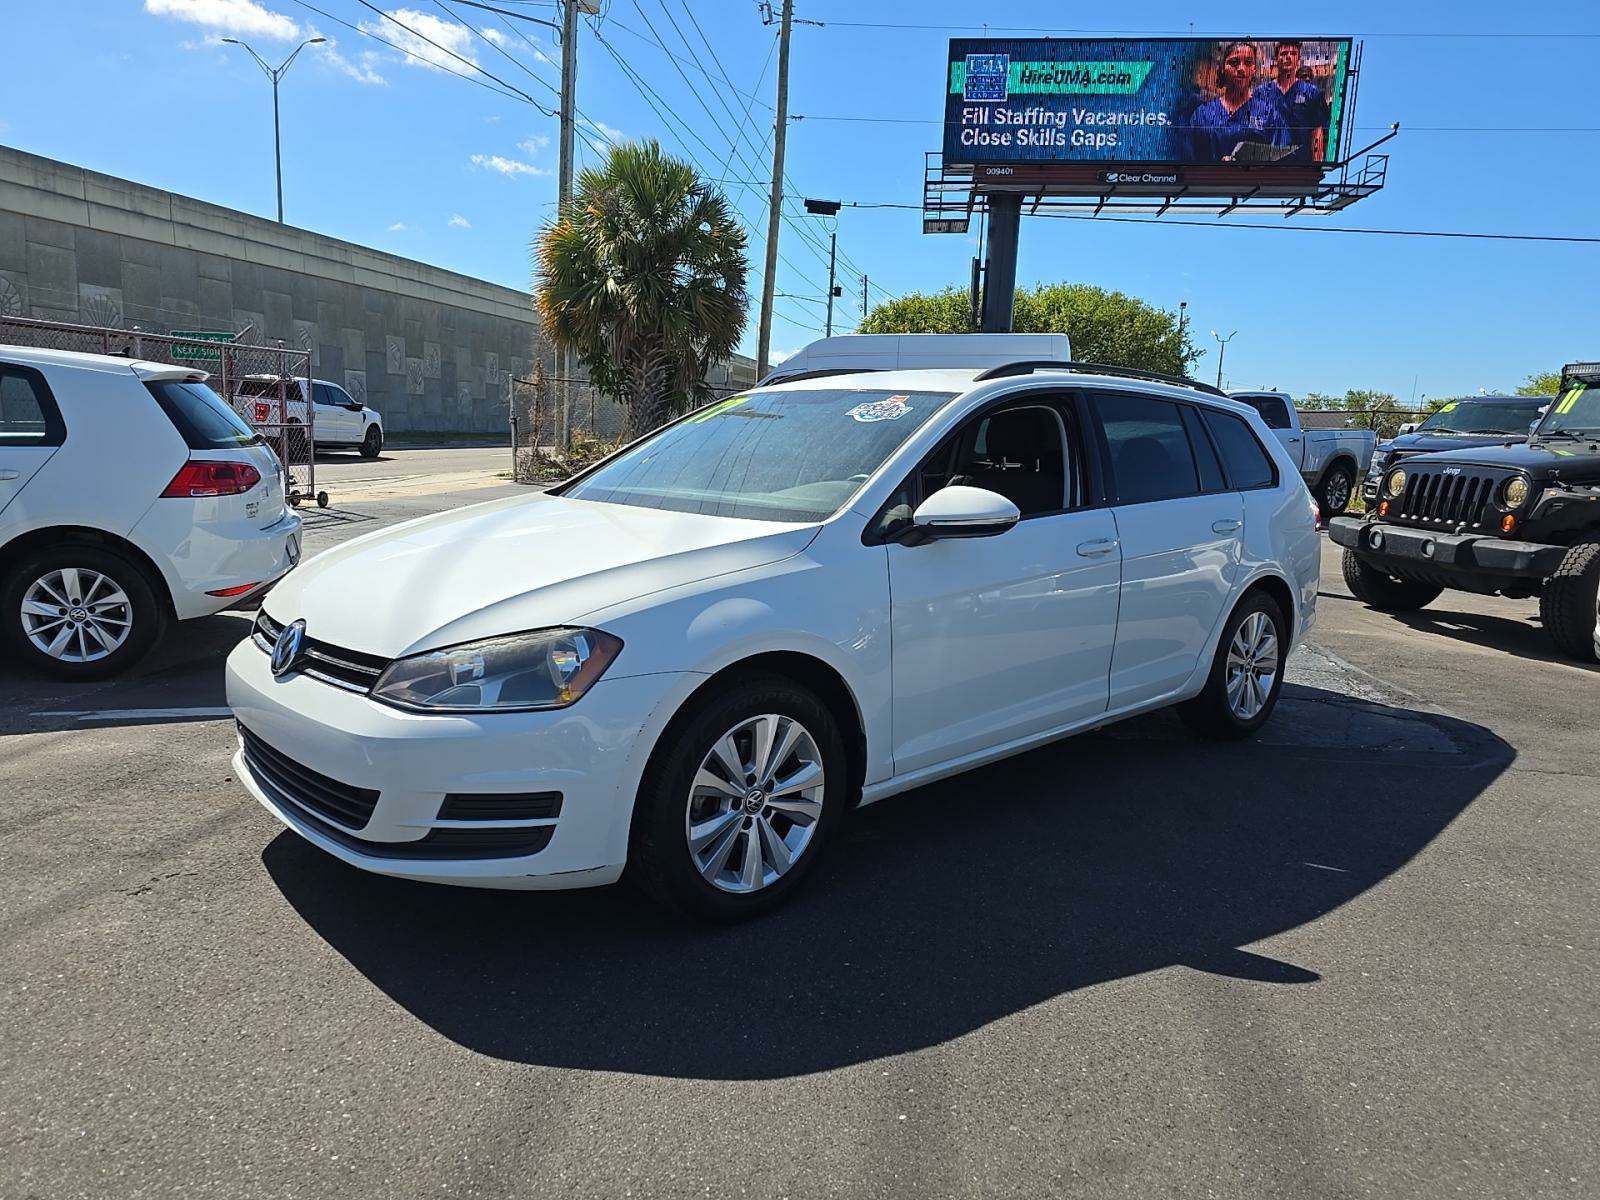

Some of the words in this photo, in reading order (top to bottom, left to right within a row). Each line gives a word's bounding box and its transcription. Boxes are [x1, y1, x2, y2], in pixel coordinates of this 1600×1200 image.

[1020, 69, 1132, 86] HireUMA.com
[962, 107, 989, 125] Fill
[994, 107, 1067, 129] Staffing
[1072, 107, 1172, 126] Vacancies.
[961, 128, 1012, 146] Close
[1016, 128, 1066, 146] Skills
[1071, 129, 1122, 150] Gaps.
[986, 167, 1014, 175] 009401
[1118, 173, 1141, 183] Clear
[1142, 173, 1177, 183] Channel
[1442, 466, 1461, 476] Jeep
